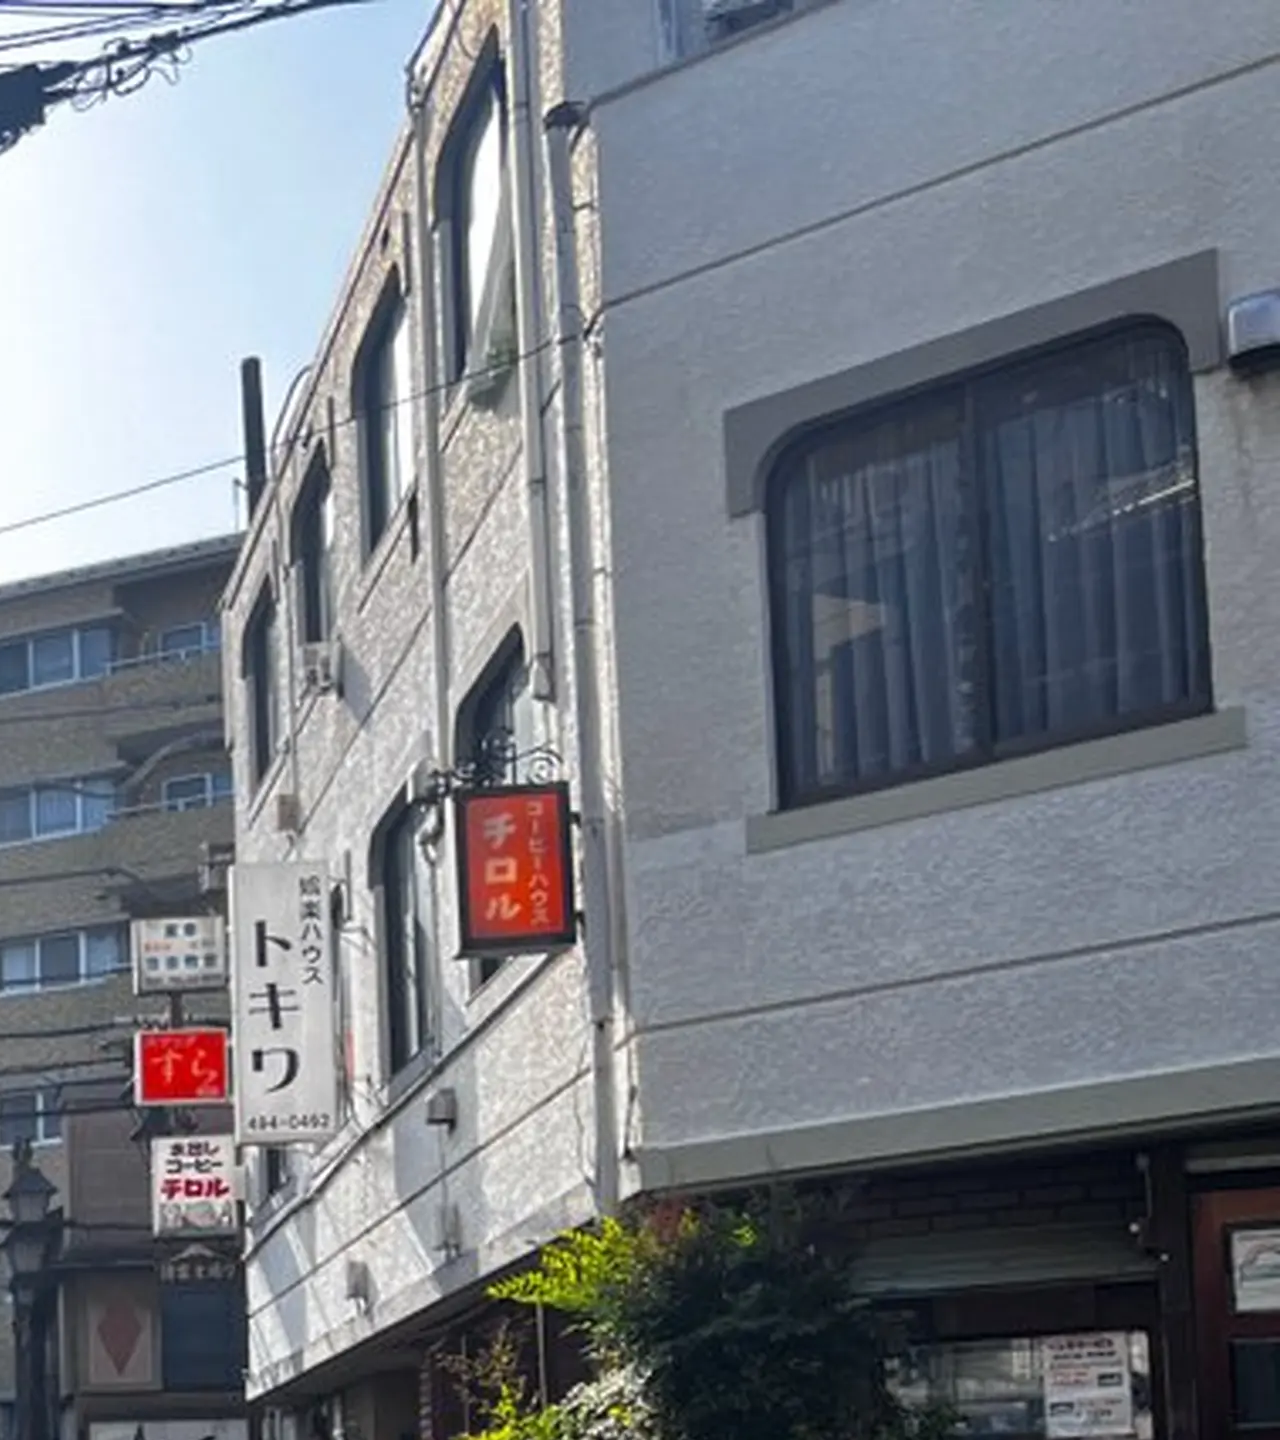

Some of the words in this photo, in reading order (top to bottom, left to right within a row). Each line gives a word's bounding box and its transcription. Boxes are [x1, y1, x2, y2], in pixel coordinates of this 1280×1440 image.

[483, 812, 522, 921] チロル
[248, 919, 301, 1094] トキワ
[160, 1176, 231, 1200] チロル
[165, 1158, 224, 1175] コーヒー
